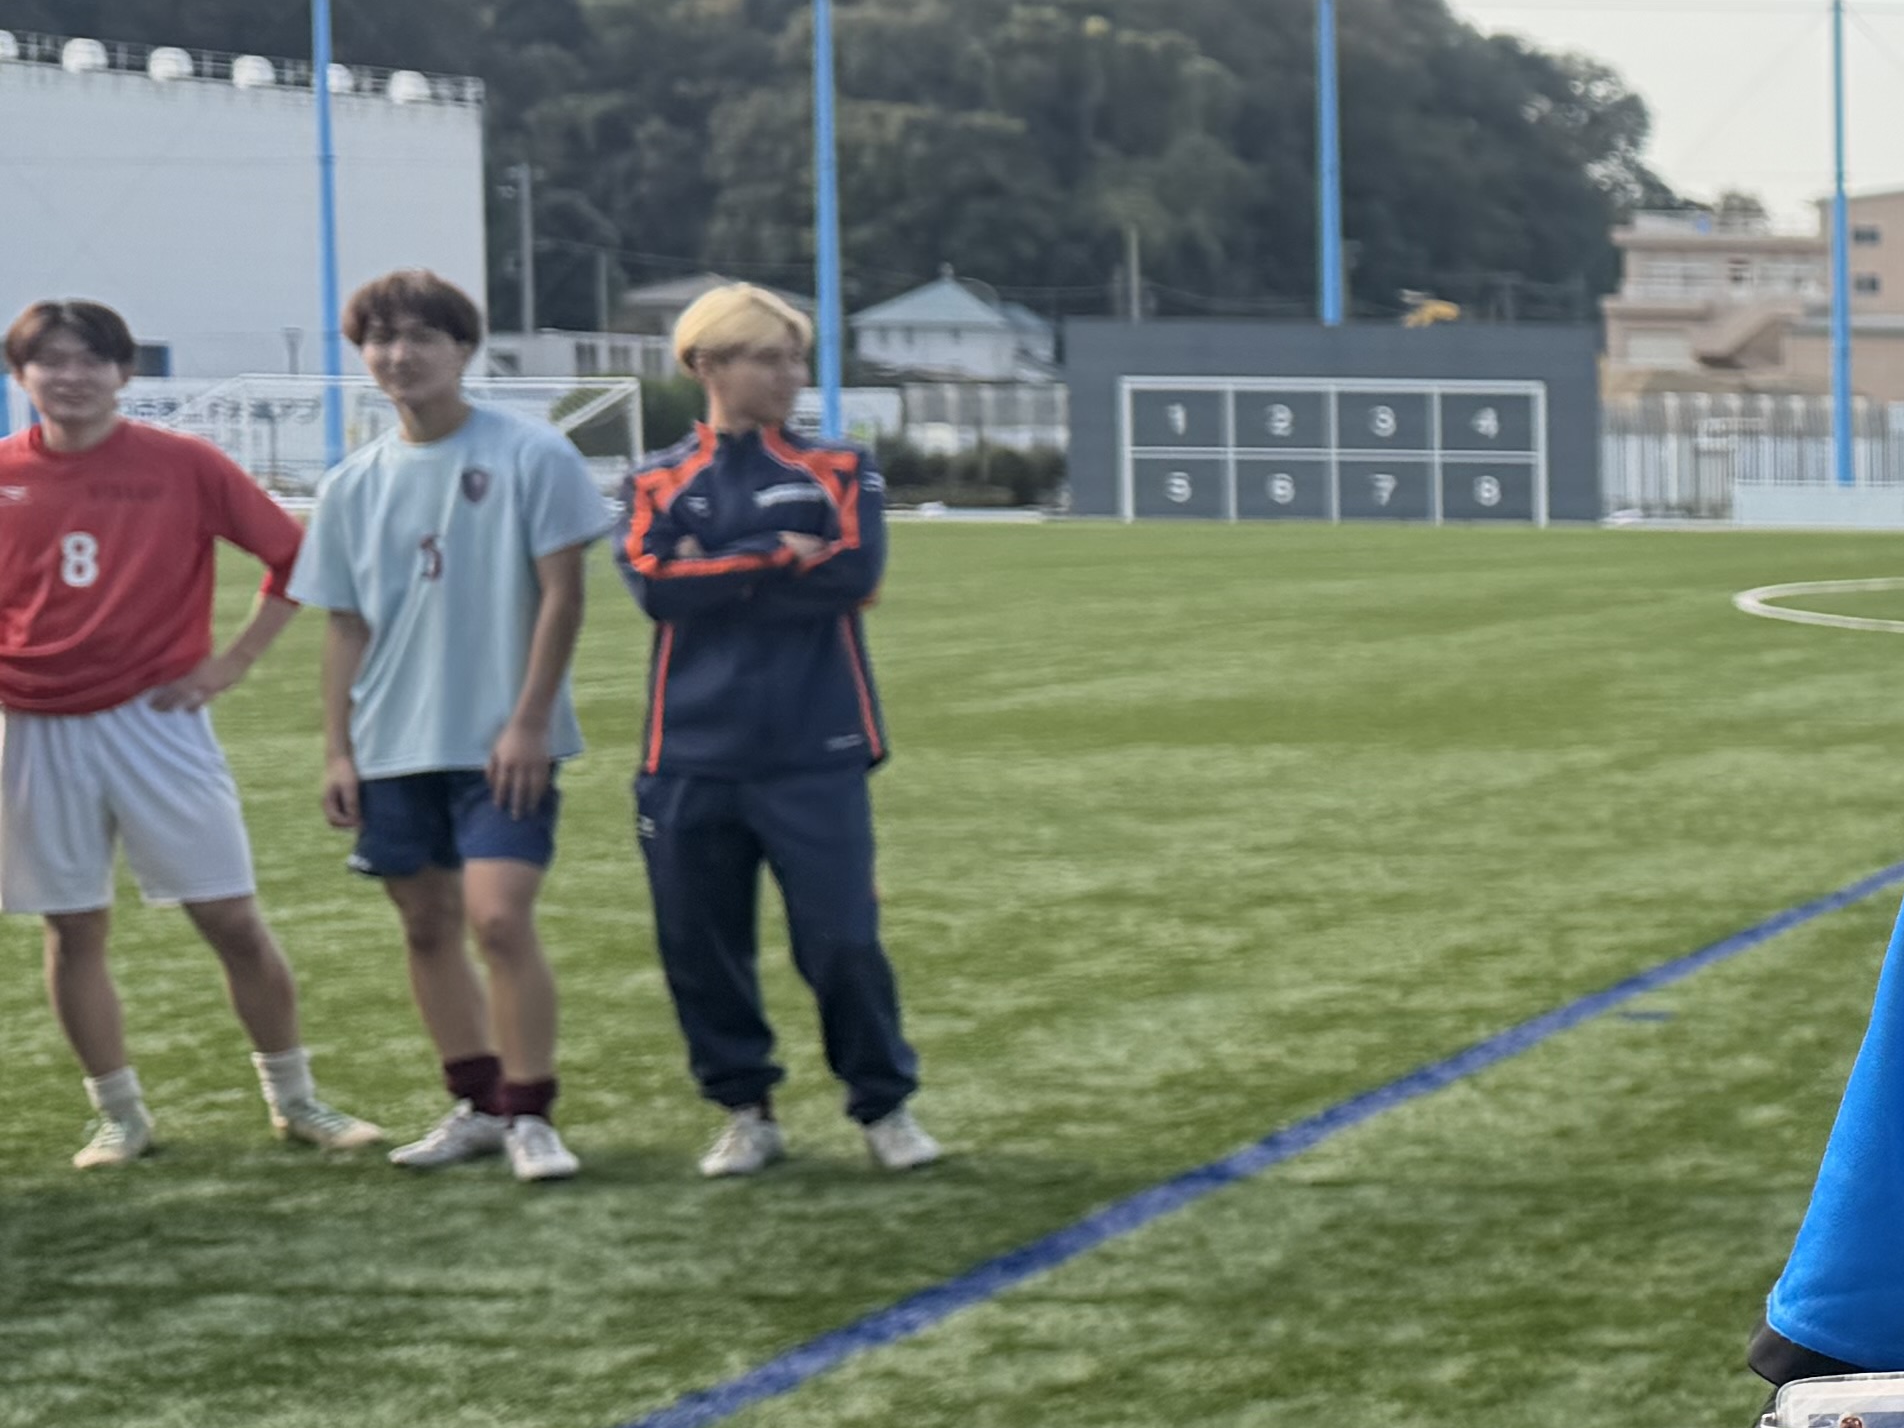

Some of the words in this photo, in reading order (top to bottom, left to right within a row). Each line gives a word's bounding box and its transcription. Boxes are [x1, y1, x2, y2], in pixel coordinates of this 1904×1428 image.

[1165, 403, 1188, 436] 1
[1264, 403, 1294, 437] 2
[1369, 405, 1397, 438] 3
[1471, 407, 1499, 439] 4
[1165, 472, 1192, 503] 5
[1266, 473, 1295, 504] 6
[1369, 473, 1397, 506] 7
[1473, 475, 1501, 506] 8
[60, 531, 99, 587] 8
